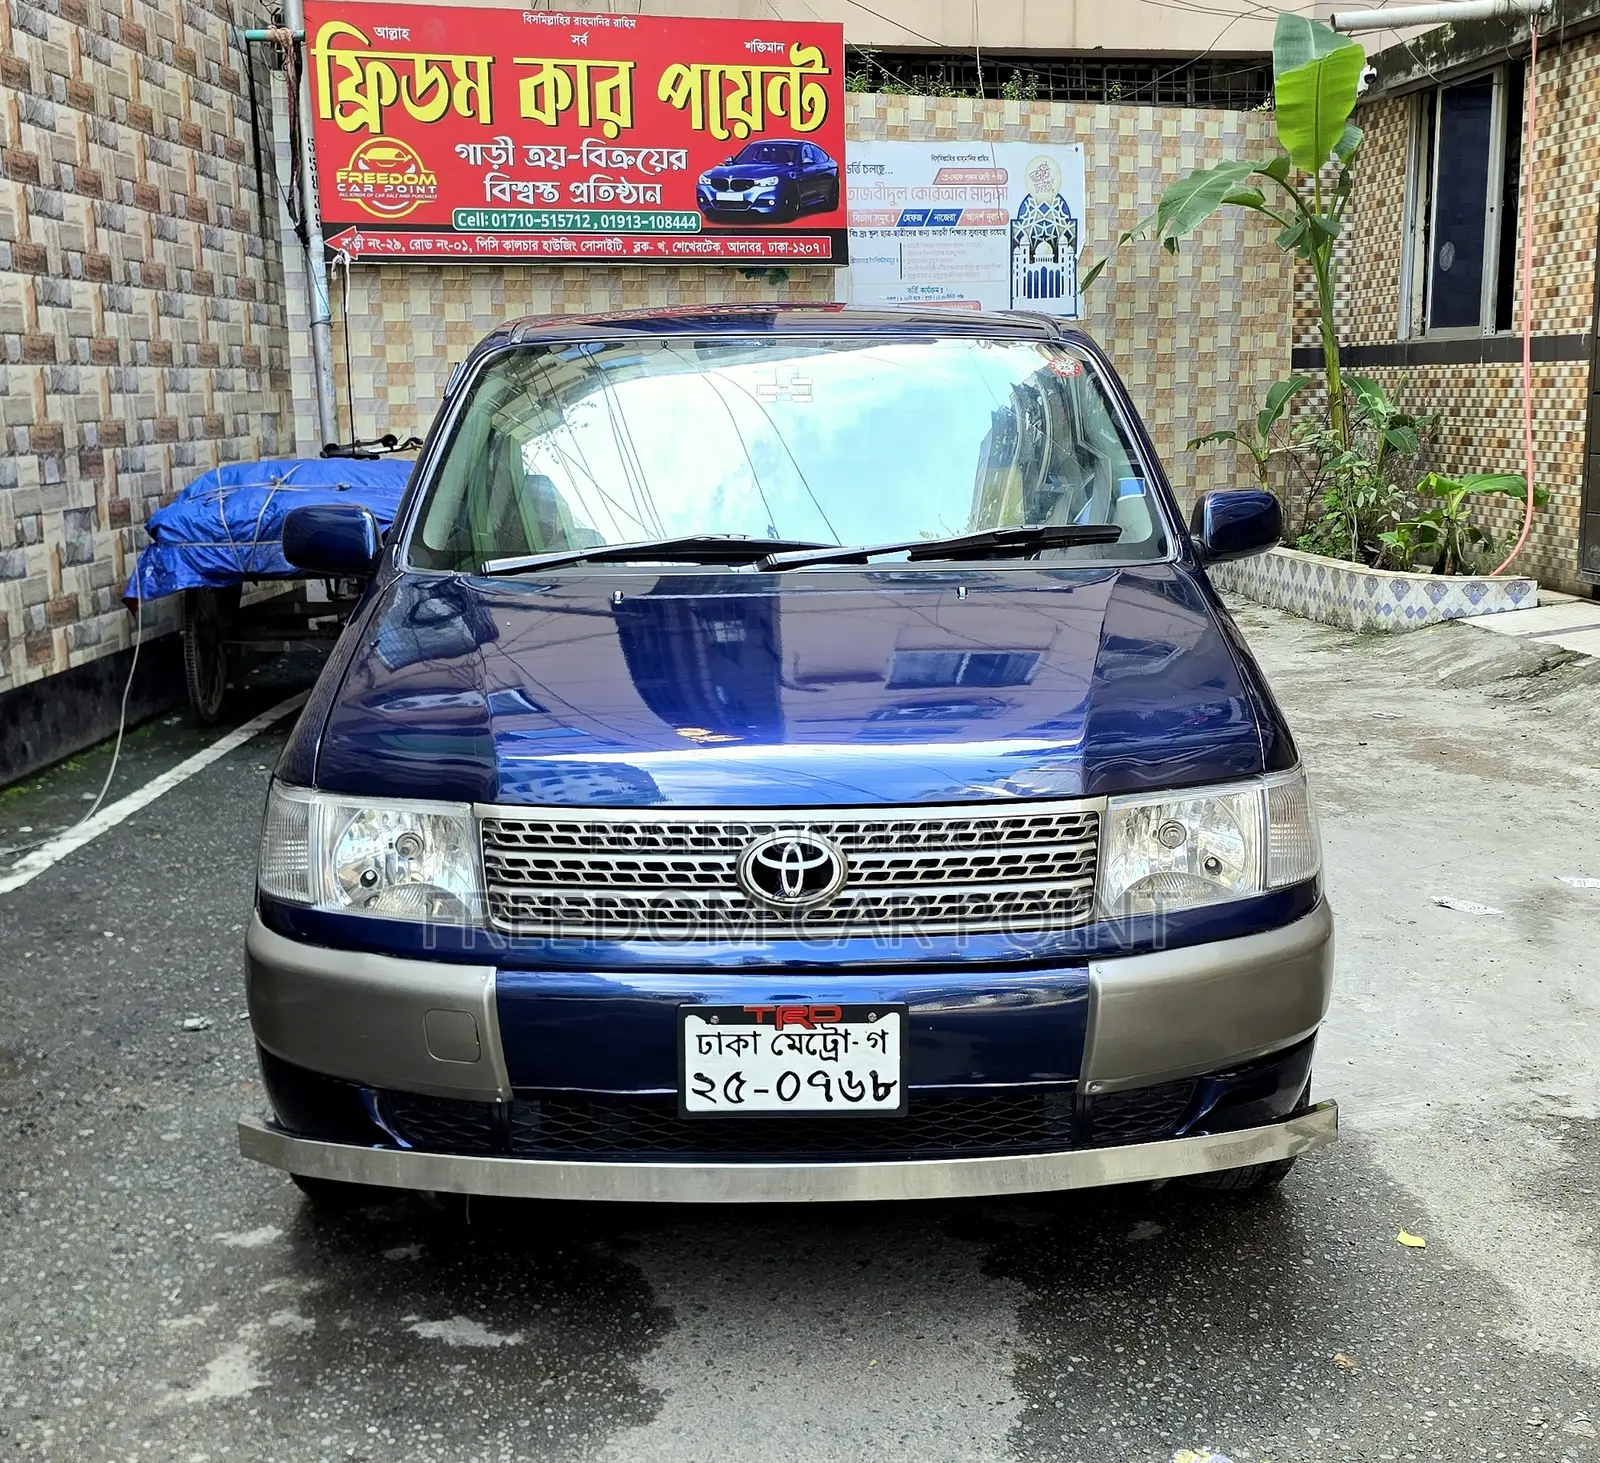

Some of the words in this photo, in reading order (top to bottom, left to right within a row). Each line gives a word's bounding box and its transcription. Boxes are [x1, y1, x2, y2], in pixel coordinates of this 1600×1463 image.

[573, 15, 611, 27] রাহমানির
[613, 17, 636, 29] রাহিম
[374, 26, 410, 41] আল্লাহ
[571, 32, 589, 47] সর্ব
[743, 38, 785, 54] শক্তিমান
[311, 20, 495, 134] ফ্রিডম
[513, 57, 637, 139] কার
[657, 42, 831, 140] পয়েন্ট
[454, 136, 515, 171] গাড়ী
[336, 172, 437, 185] FREEDOM
[337, 184, 374, 193] CAR
[384, 185, 436, 193] POINT
[483, 172, 561, 205] বিশ্বস্ত
[569, 174, 663, 205] প্রতিষ্ঠান
[911, 187, 967, 202] কোরআন
[457, 212, 490, 227] Cell:
[600, 214, 697, 229] 01913-108444
[409, 238, 433, 251] রোড
[475, 236, 499, 252] পিসি
[501, 239, 540, 252] কালচার
[541, 237, 578, 253] হাউজিং
[580, 237, 627, 254] সোসাইটি,
[672, 239, 724, 255] শেখেরটেক,
[727, 241, 765, 255] আদাবর,
[743, 1005, 842, 1031] TRD
[696, 1030, 762, 1057] ঢাকা
[691, 1070, 898, 1104] ২৫-০৭৬৮
